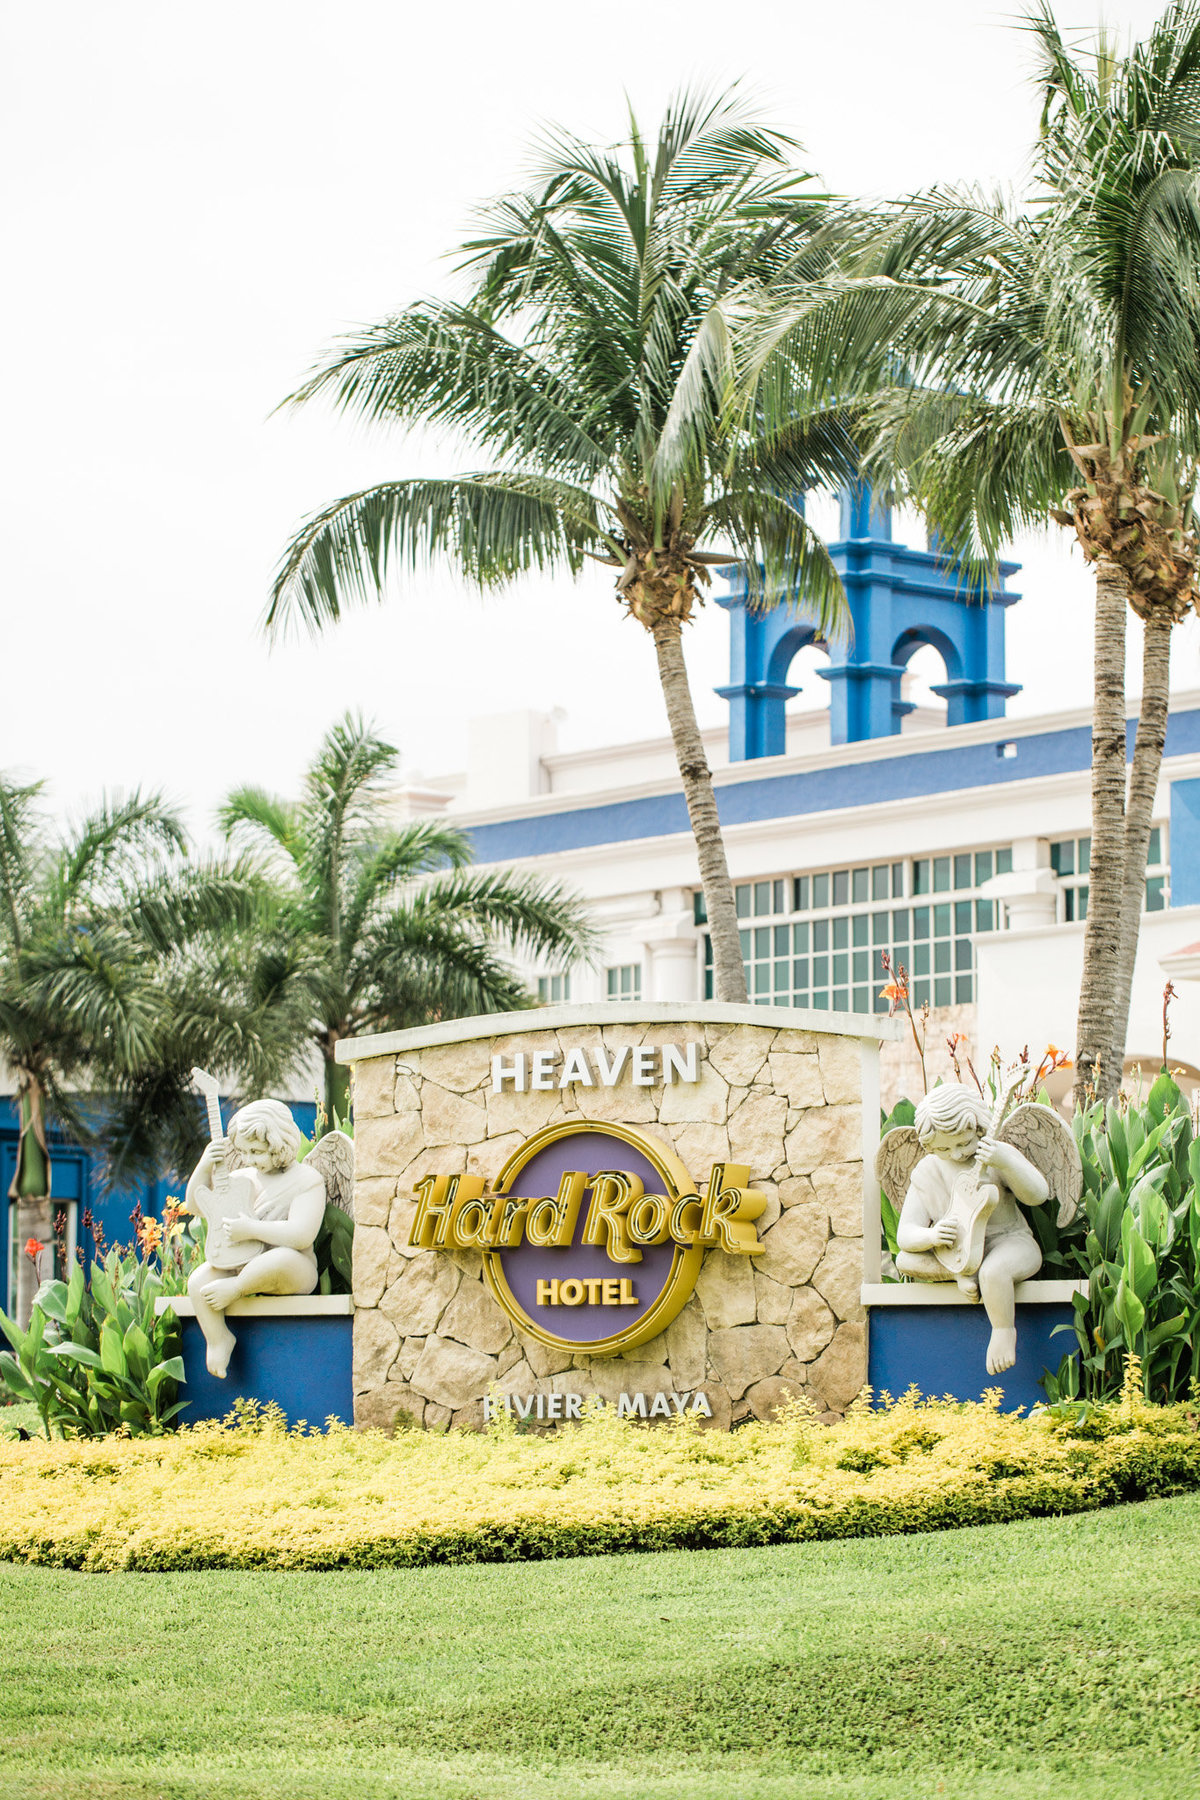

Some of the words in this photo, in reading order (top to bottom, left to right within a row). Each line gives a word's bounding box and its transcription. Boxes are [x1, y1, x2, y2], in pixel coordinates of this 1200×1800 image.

[492, 1042, 700, 1092] HEAVEN
[408, 1172, 588, 1249] Hard
[582, 1162, 768, 1263] Rock
[536, 1278, 639, 1306] HOTEL
[617, 1392, 713, 1418] MAYA
